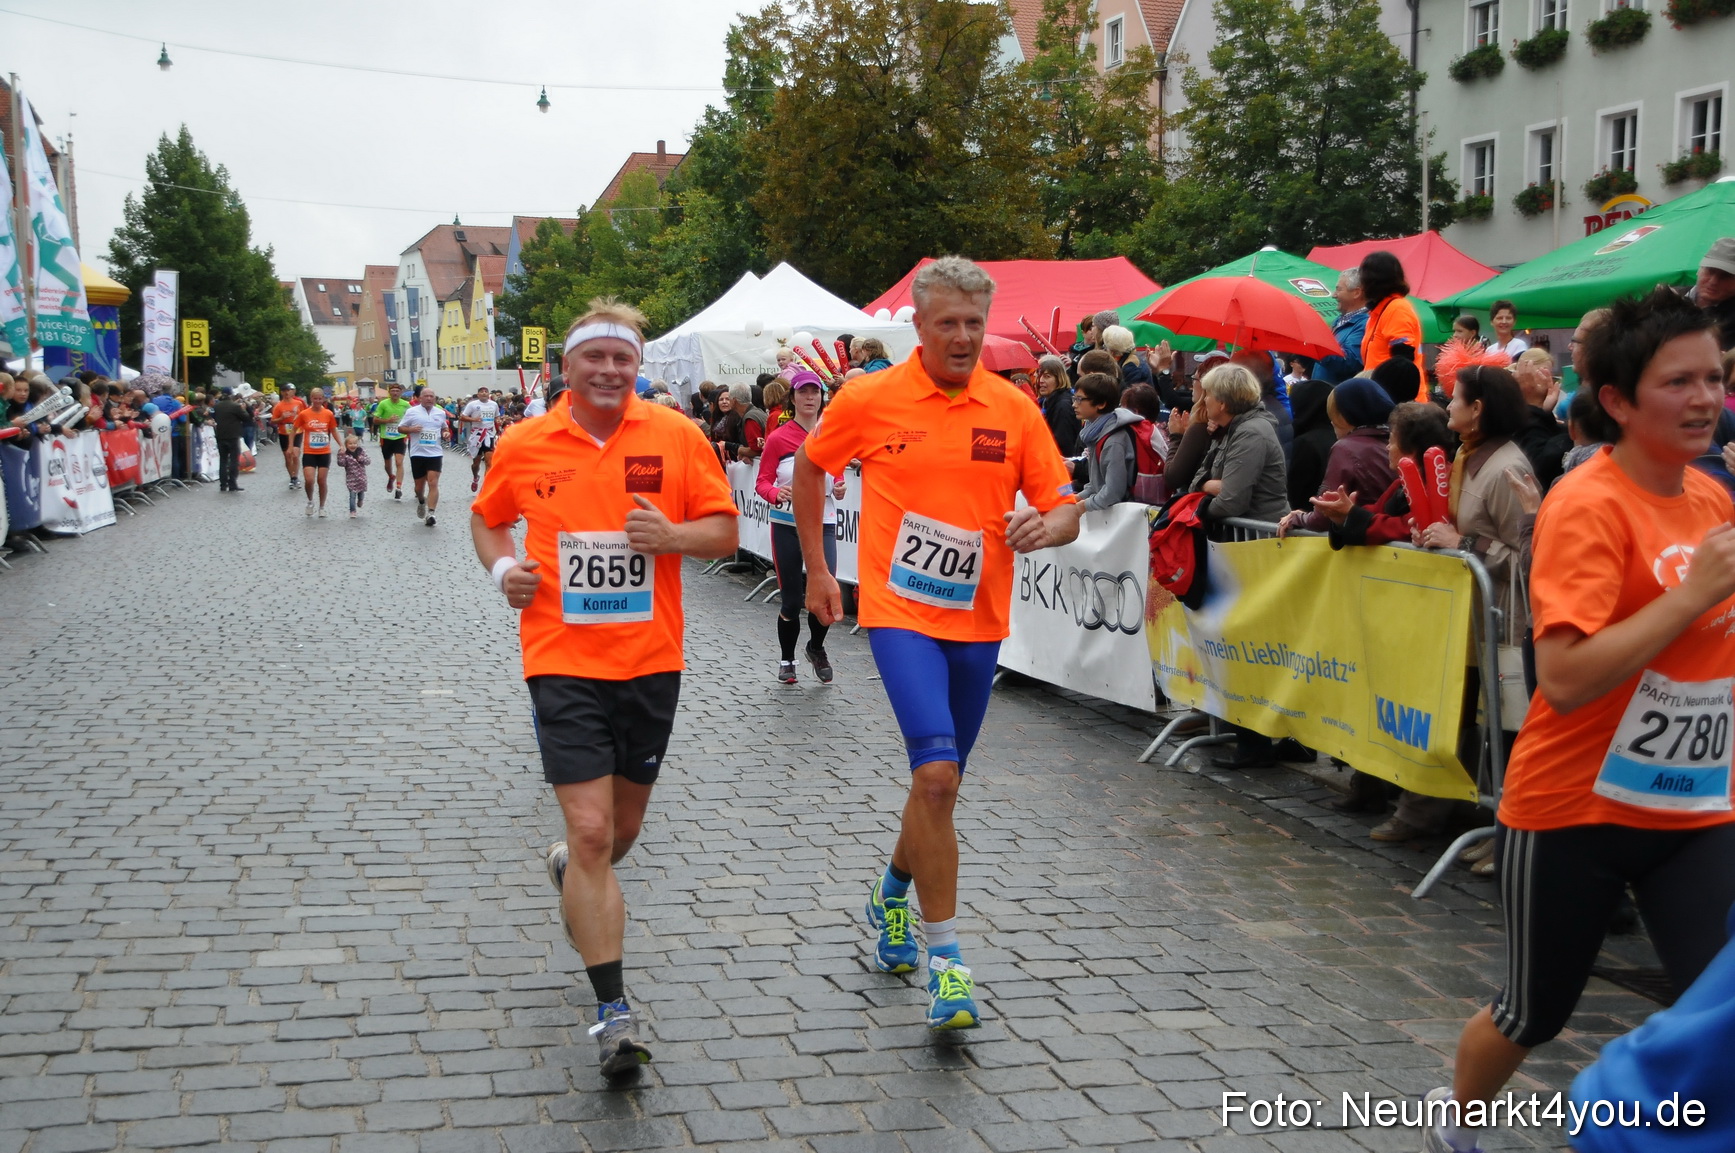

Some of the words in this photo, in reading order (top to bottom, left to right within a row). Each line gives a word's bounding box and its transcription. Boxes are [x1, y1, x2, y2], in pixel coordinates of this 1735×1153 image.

[186, 321, 206, 329] Block
[525, 328, 544, 336] Block
[190, 331, 203, 348] B
[528, 337, 540, 354] B
[719, 363, 757, 375] Kinder
[758, 363, 781, 375] brau
[420, 432, 436, 440] 2591
[971, 434, 1006, 447] Meier
[625, 463, 663, 478] Meier
[836, 508, 860, 544] BM
[903, 518, 931, 535] PARTL
[933, 529, 975, 548] Neumarkt
[560, 540, 590, 550] PARTL
[592, 541, 629, 550] Neumar
[901, 534, 977, 580] 2704
[568, 554, 646, 588] 2659
[907, 575, 955, 598] Gerhard
[1020, 556, 1068, 615] BKK
[583, 597, 628, 611] Konrad
[1639, 683, 1681, 707] PARTL
[1374, 693, 1432, 752] KANN
[1627, 710, 1728, 761] 2780
[1615, 744, 1622, 753] C
[1650, 773, 1694, 792] Anita
